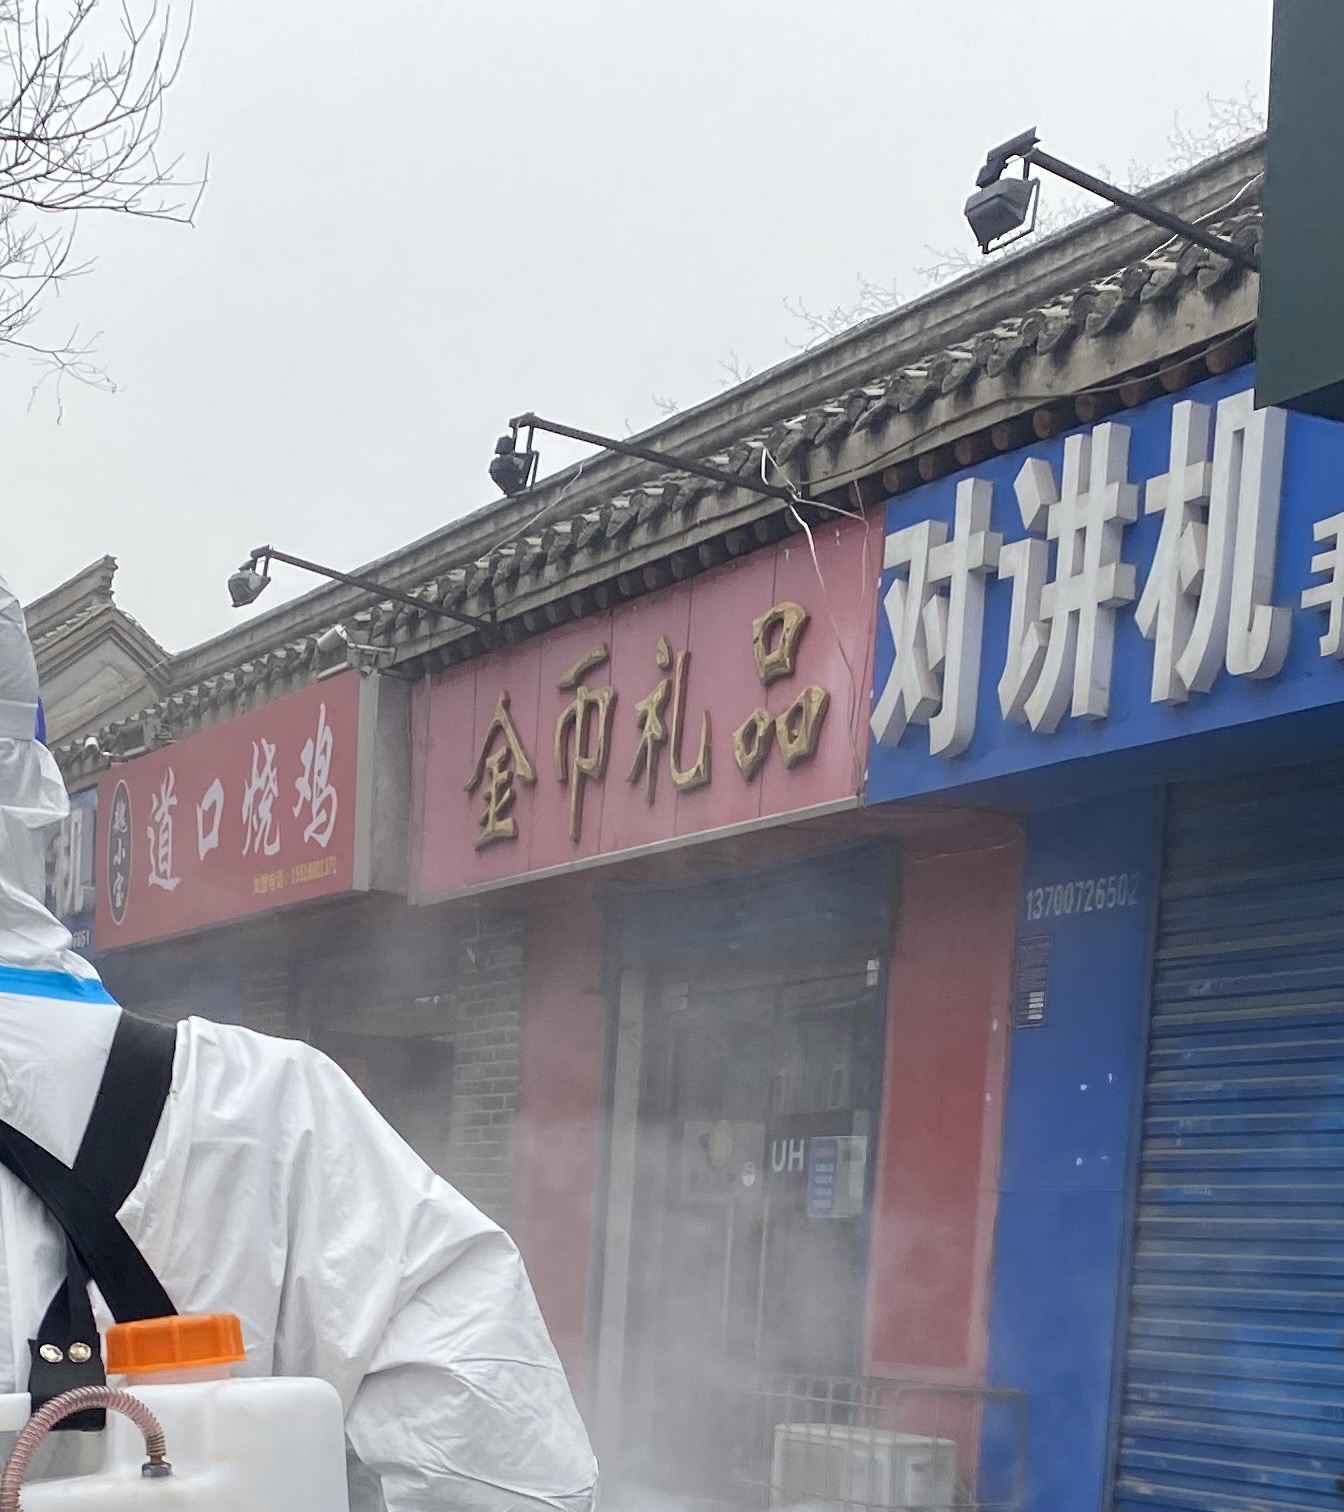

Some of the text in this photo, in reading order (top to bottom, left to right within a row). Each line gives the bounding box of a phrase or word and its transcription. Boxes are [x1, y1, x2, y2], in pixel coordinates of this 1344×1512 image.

[869, 388, 1293, 759] 对讲机
[146, 702, 339, 892] 道口烧鸡
[464, 601, 831, 850] 金币礼品
[1026, 872, 1140, 921] 13700726502
